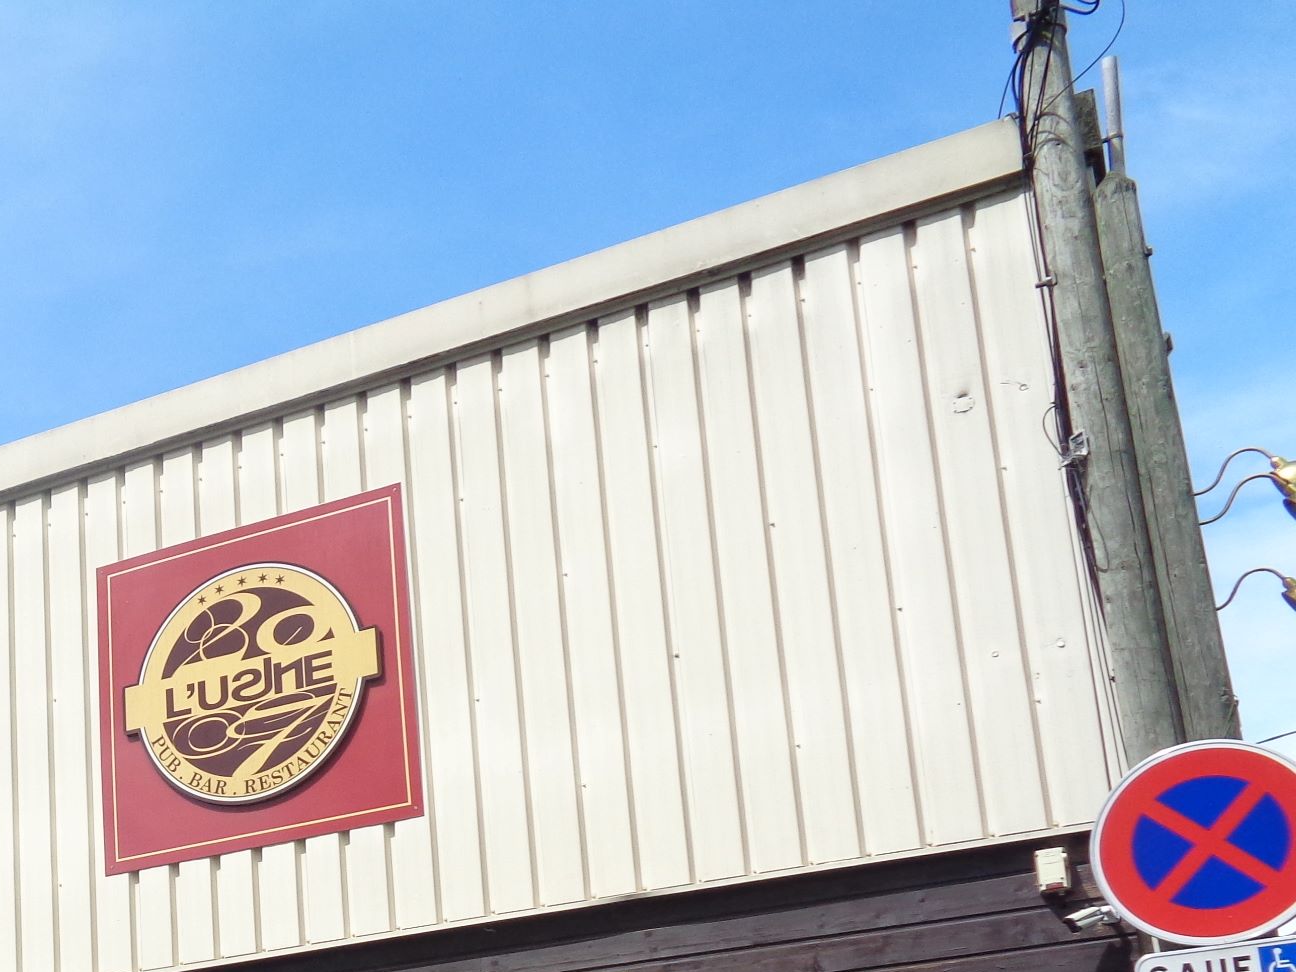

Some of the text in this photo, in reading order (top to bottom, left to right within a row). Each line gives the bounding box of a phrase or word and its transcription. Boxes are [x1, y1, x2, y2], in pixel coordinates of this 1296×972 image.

[151, 687, 353, 795] PUB BAR RESTAURANT
